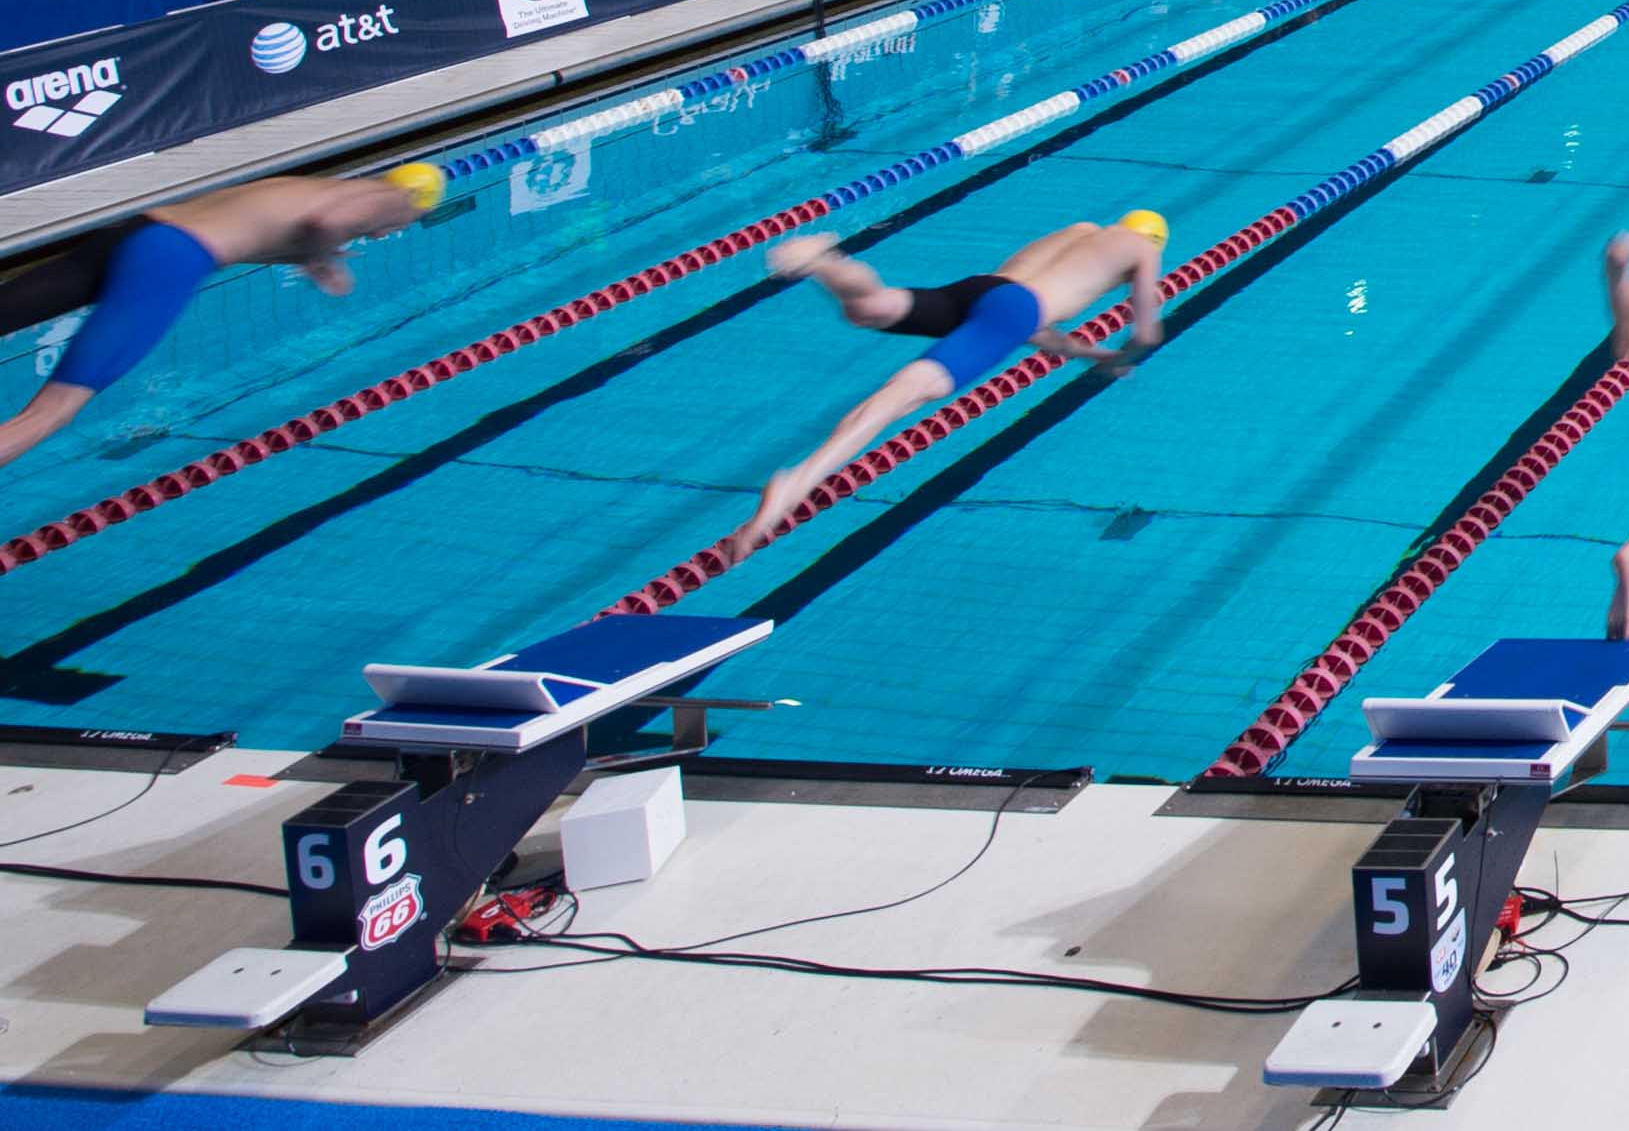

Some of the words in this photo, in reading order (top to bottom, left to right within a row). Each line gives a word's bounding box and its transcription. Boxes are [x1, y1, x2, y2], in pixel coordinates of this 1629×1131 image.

[315, 5, 400, 52] at&t
[6, 57, 119, 110] arena
[297, 833, 335, 889] 6
[364, 813, 407, 885] 6
[368, 882, 411, 916] PHILLIPS
[373, 898, 411, 938] 66
[1371, 877, 1410, 935] 5
[1434, 852, 1457, 931] 5
